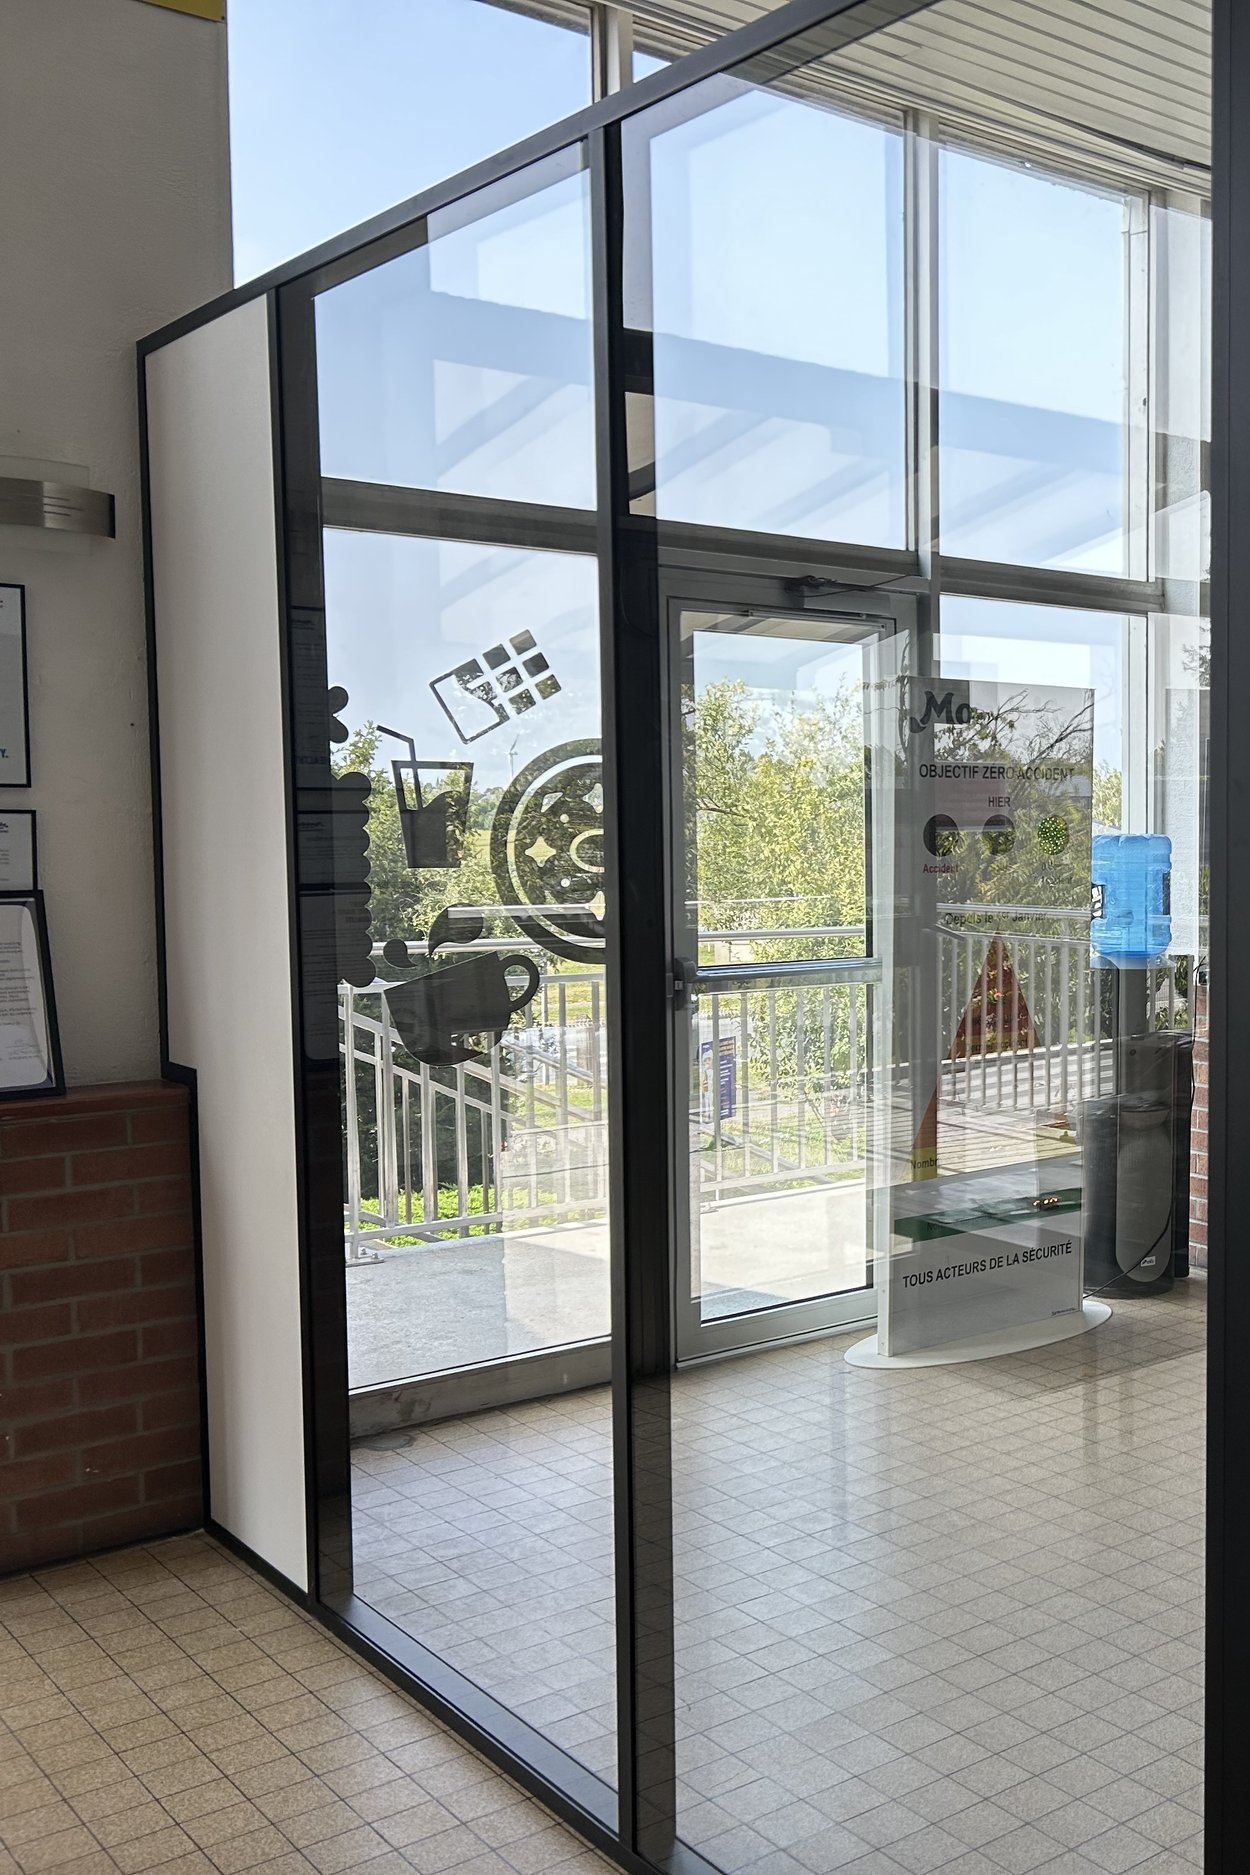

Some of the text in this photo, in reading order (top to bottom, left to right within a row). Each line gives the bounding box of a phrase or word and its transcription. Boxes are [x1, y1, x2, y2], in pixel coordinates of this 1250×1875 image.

[919, 763, 979, 779] OBJECTIF
[1018, 766, 1075, 781] ACCIDENT
[988, 796, 1011, 808] HIER
[922, 863, 959, 874] Accident
[903, 1240, 1073, 1288] TOUS ACTEURS DE LA SÉCURITÉ
